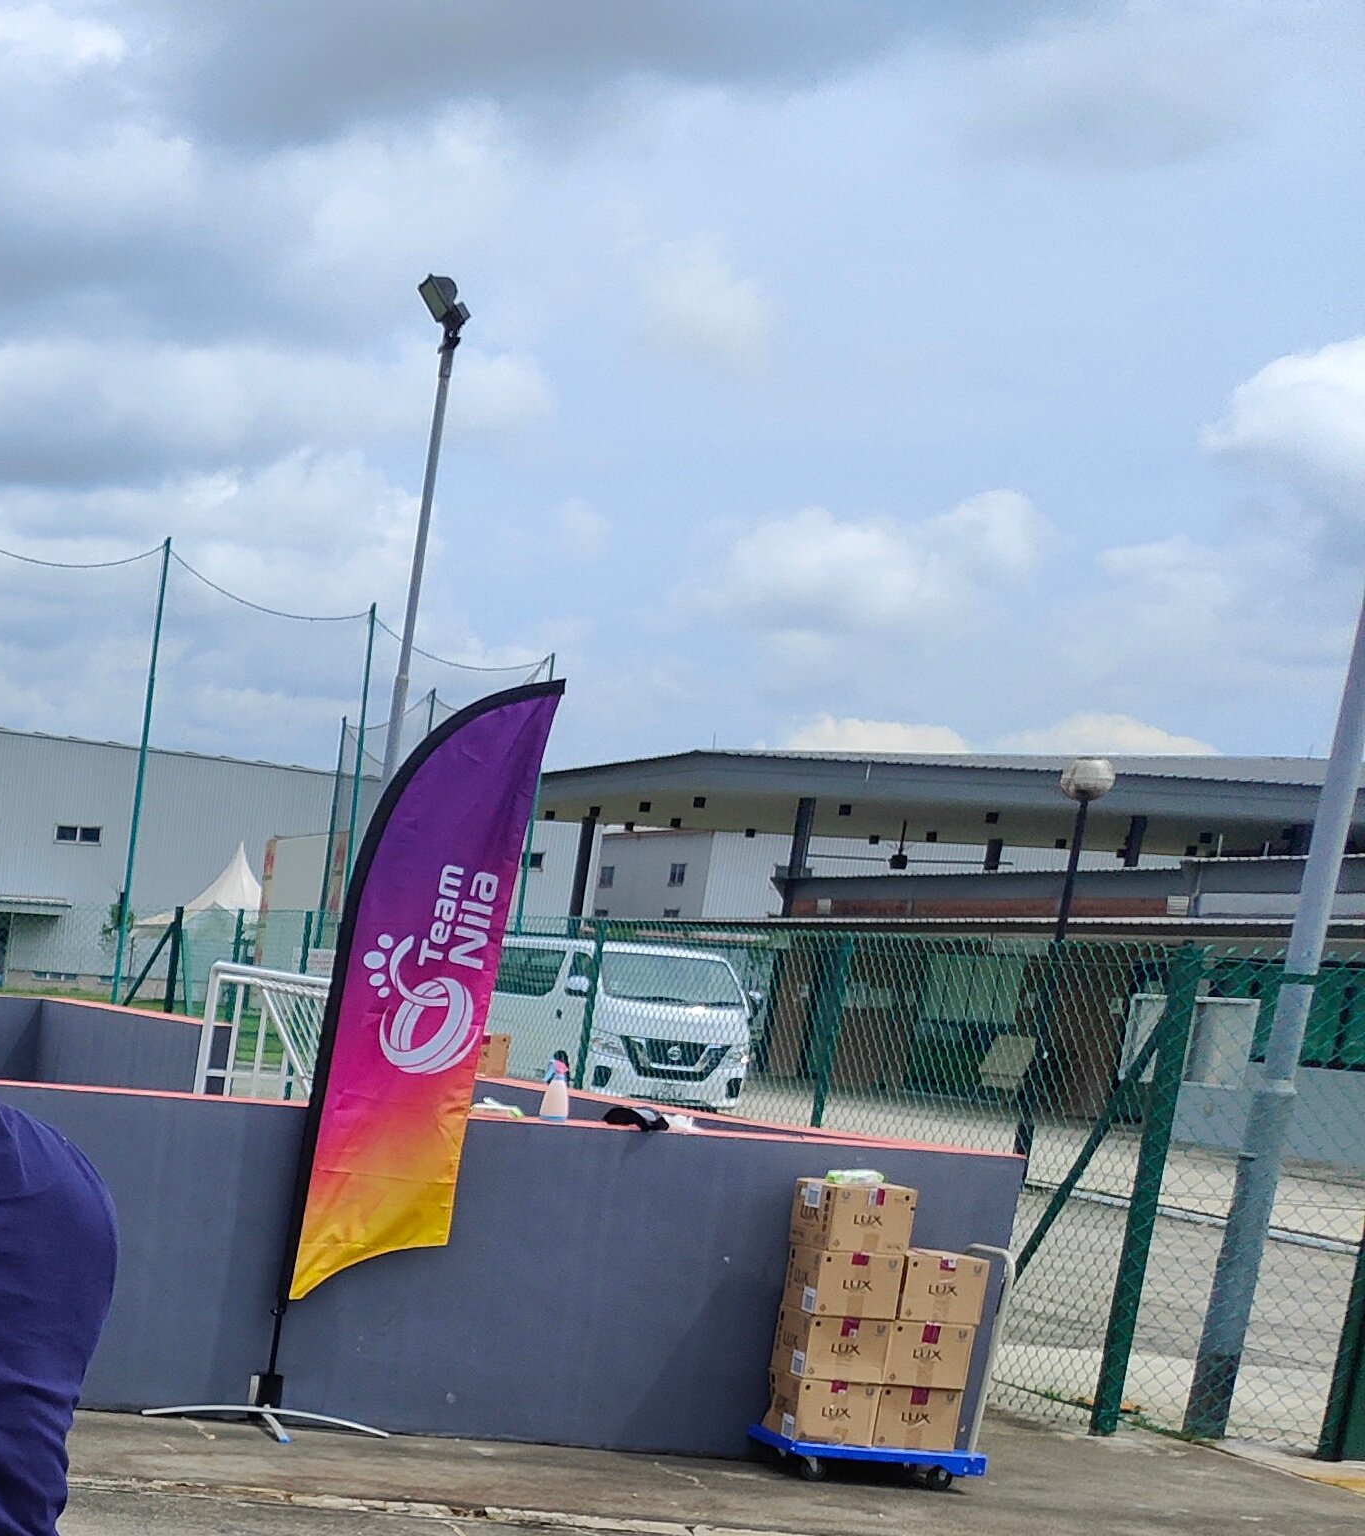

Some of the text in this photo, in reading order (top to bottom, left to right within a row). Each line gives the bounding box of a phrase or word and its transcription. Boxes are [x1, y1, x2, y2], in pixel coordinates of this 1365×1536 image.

[417, 863, 465, 968] Team
[448, 870, 500, 971] Nila
[852, 1213, 883, 1226] LUX
[842, 1279, 873, 1292] LUX
[928, 1284, 958, 1297] LUX
[830, 1342, 861, 1356] LUX
[912, 1348, 942, 1361] LUX
[821, 1406, 851, 1419] LUX
[901, 1411, 931, 1424] LUX
